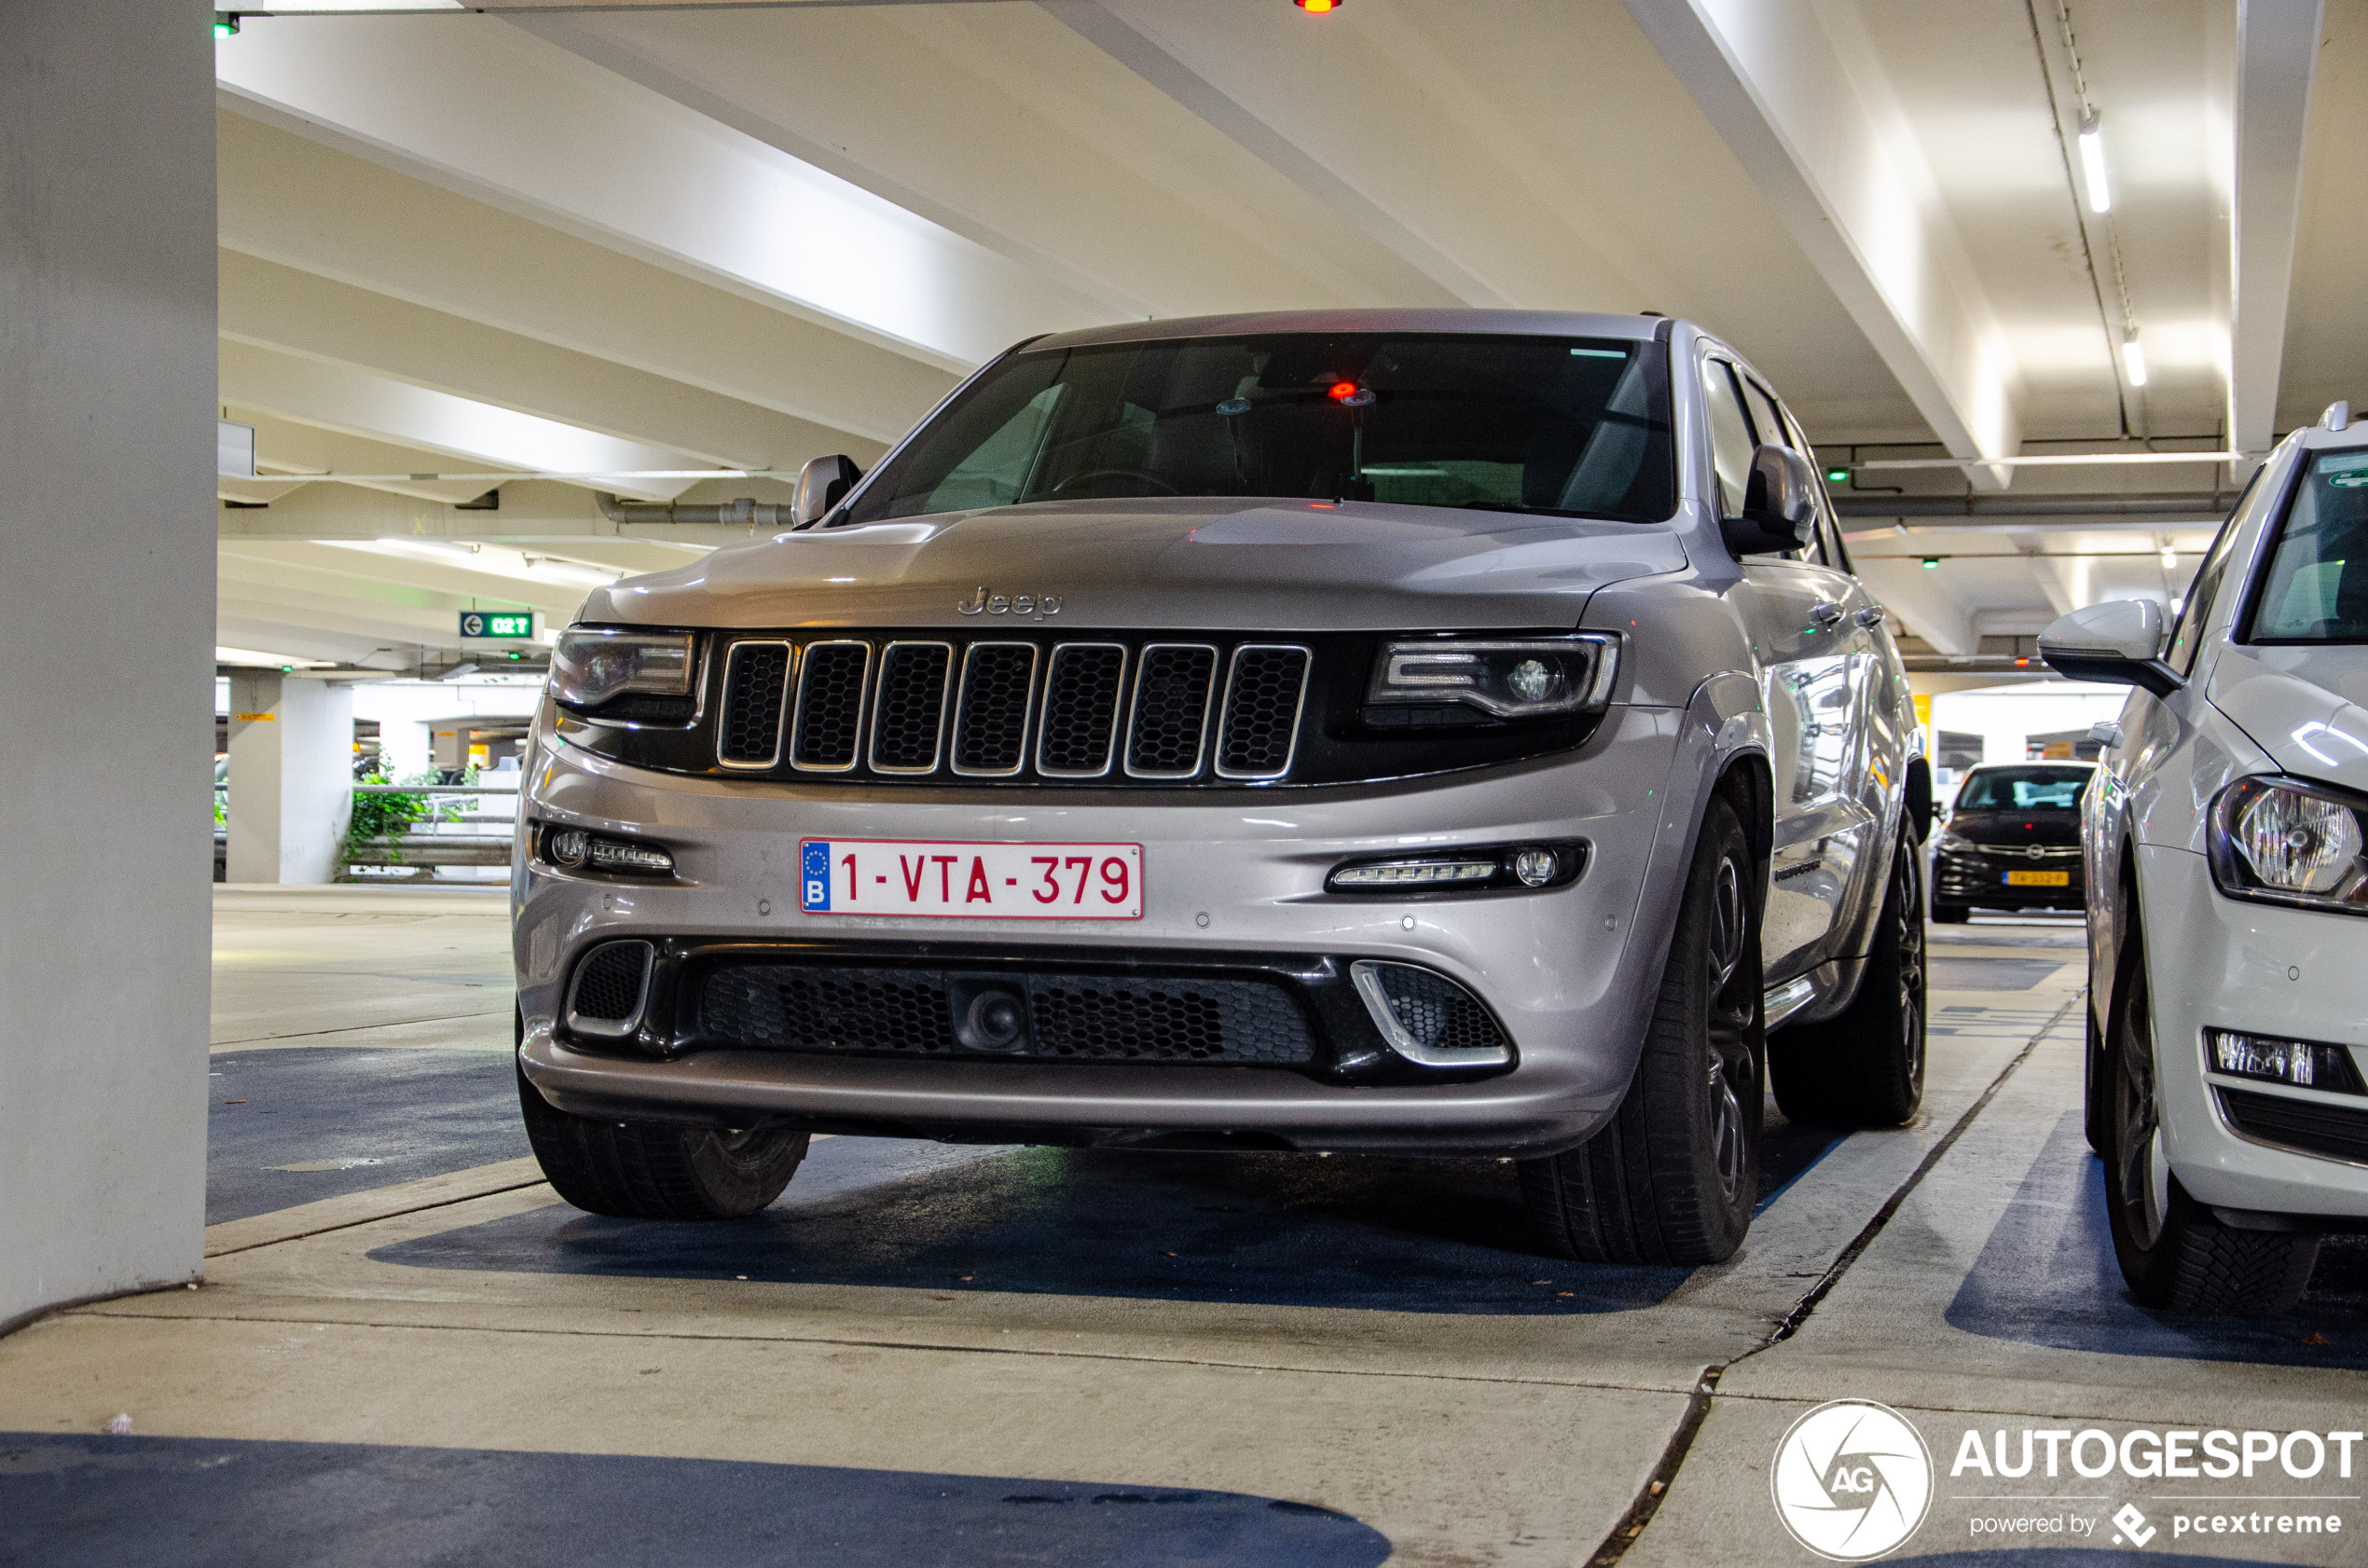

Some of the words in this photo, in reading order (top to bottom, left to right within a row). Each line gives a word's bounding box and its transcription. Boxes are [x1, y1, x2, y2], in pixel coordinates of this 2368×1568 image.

[957, 586, 1063, 621] Jeep
[806, 881, 824, 904] B
[841, 853, 1129, 904] 1-VTA-379
